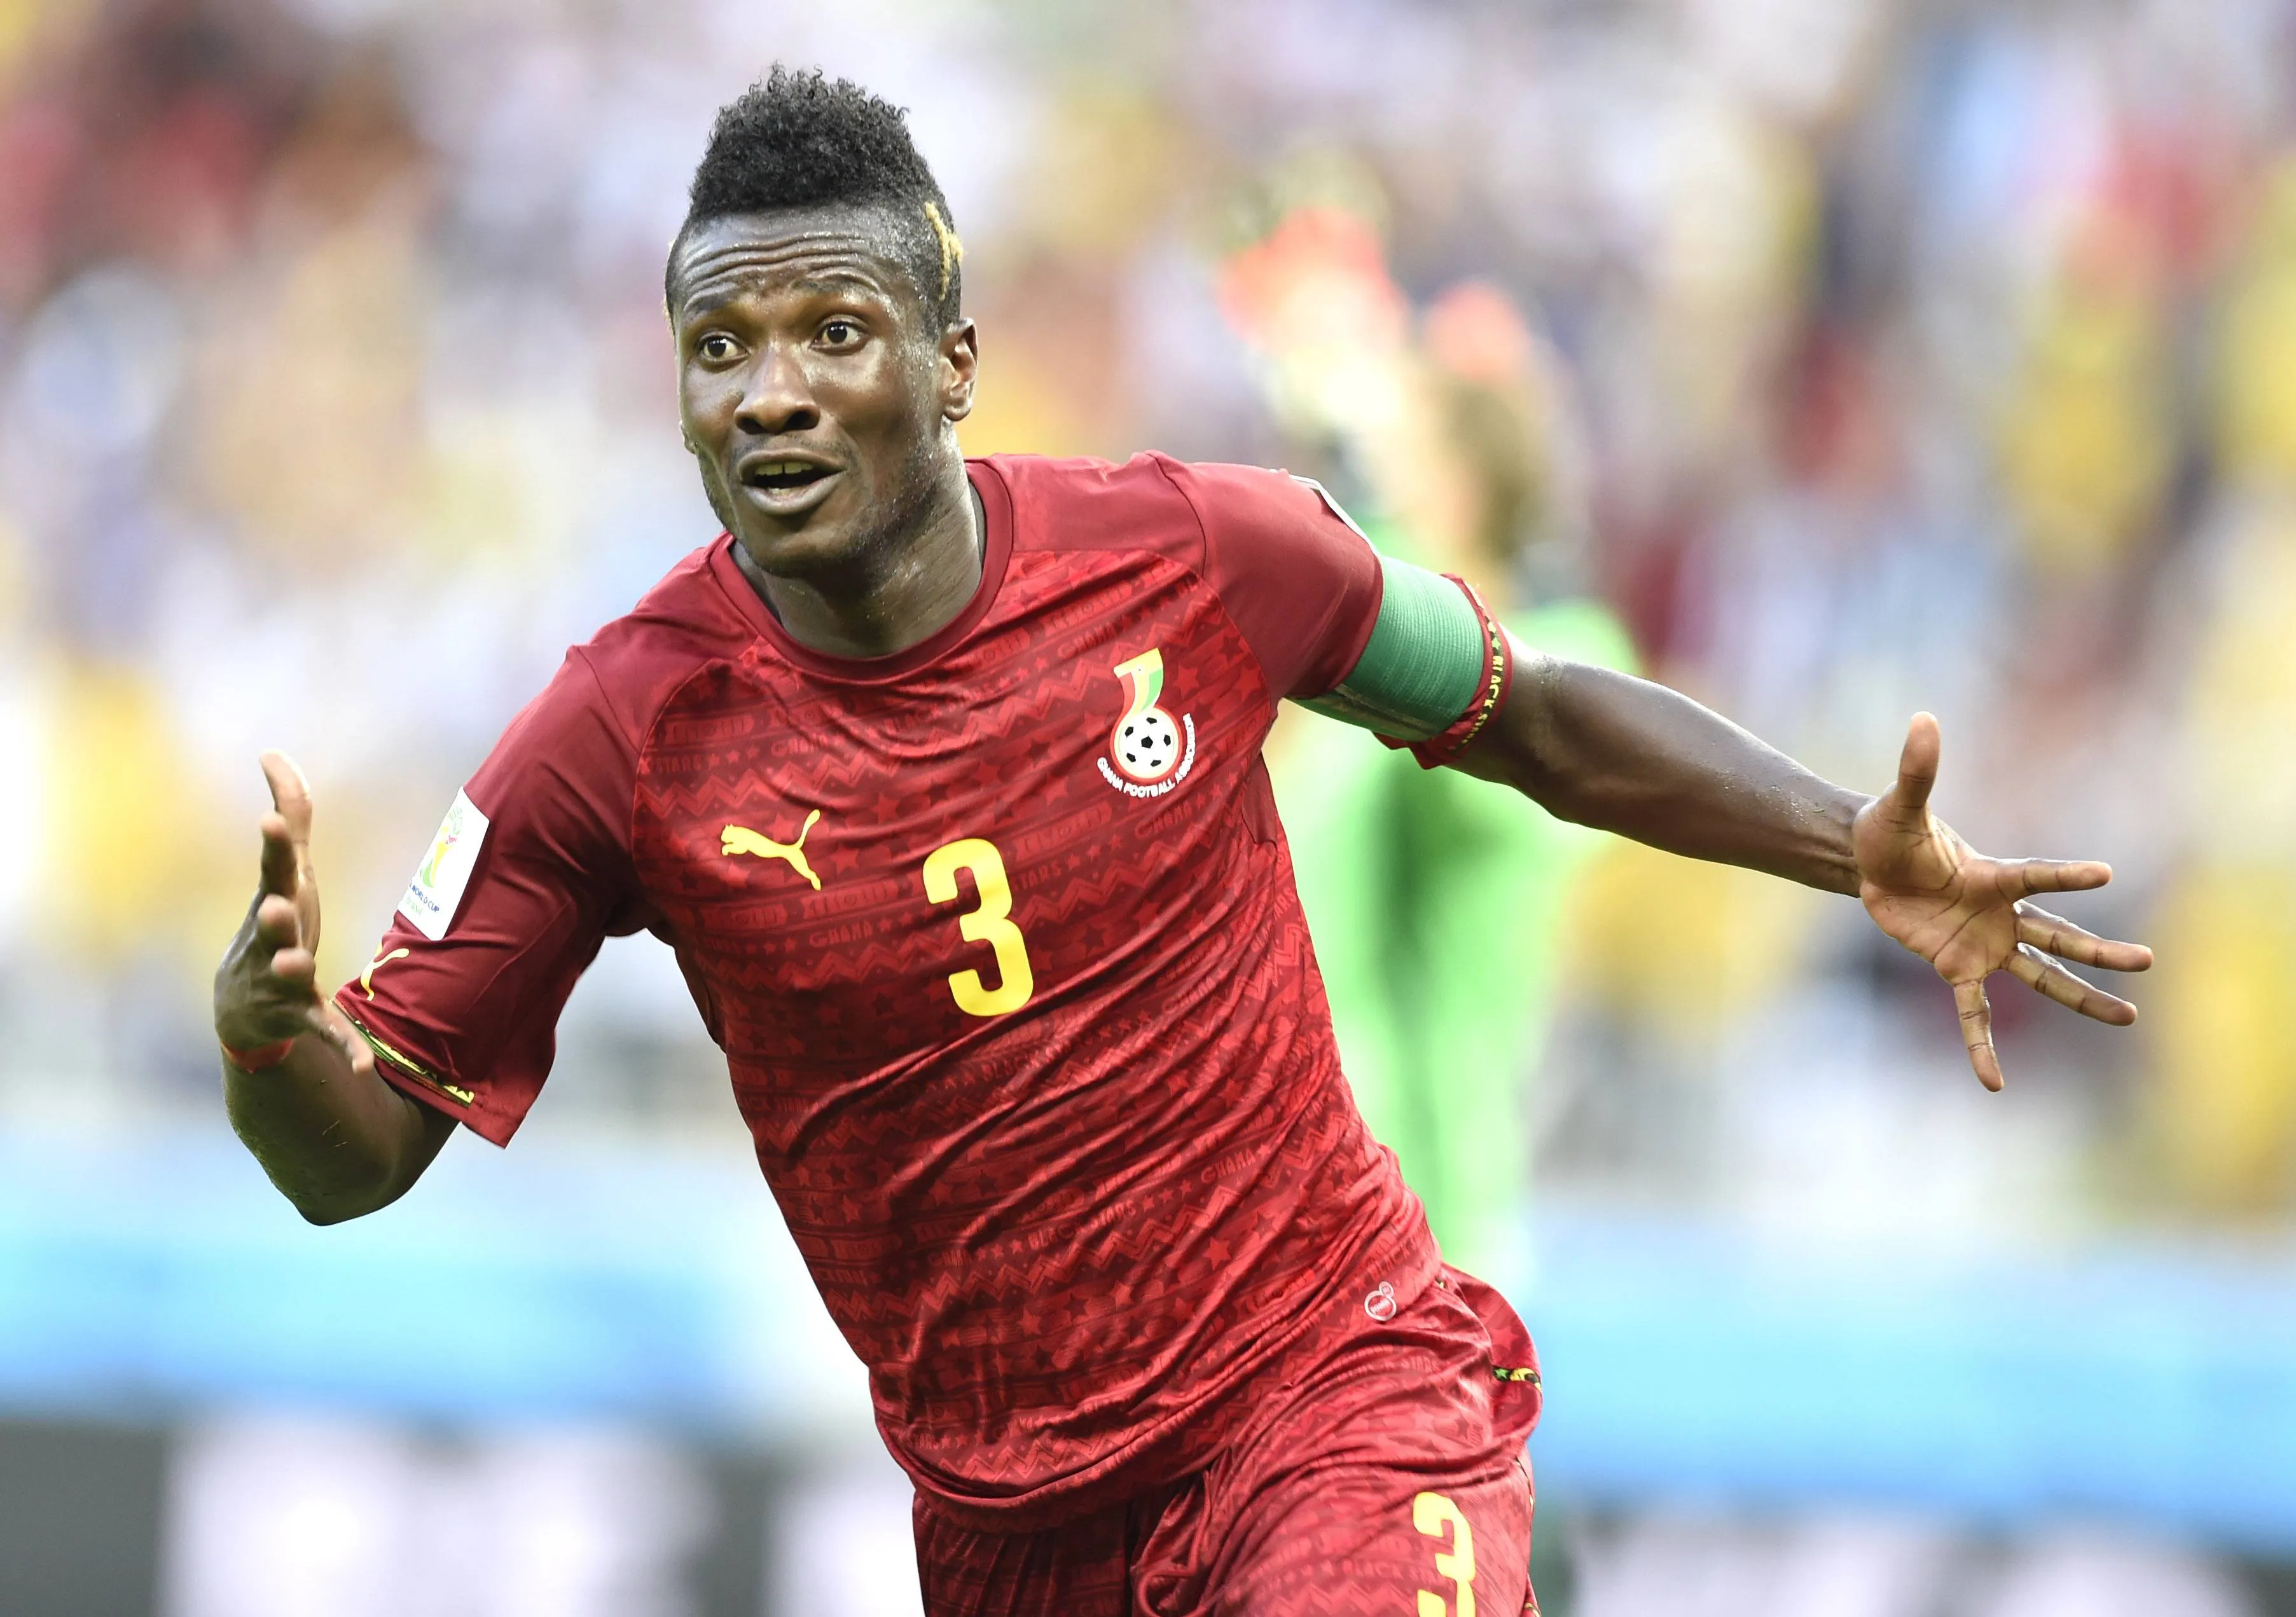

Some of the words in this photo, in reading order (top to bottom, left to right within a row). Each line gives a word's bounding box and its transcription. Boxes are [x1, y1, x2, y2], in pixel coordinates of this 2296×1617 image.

[1484, 656, 1504, 709] BLACK
[1123, 778, 1176, 799] FOOTBALL
[428, 900, 439, 912] CUP
[922, 837, 1034, 1017] 3
[1413, 1491, 1476, 1617] 3
